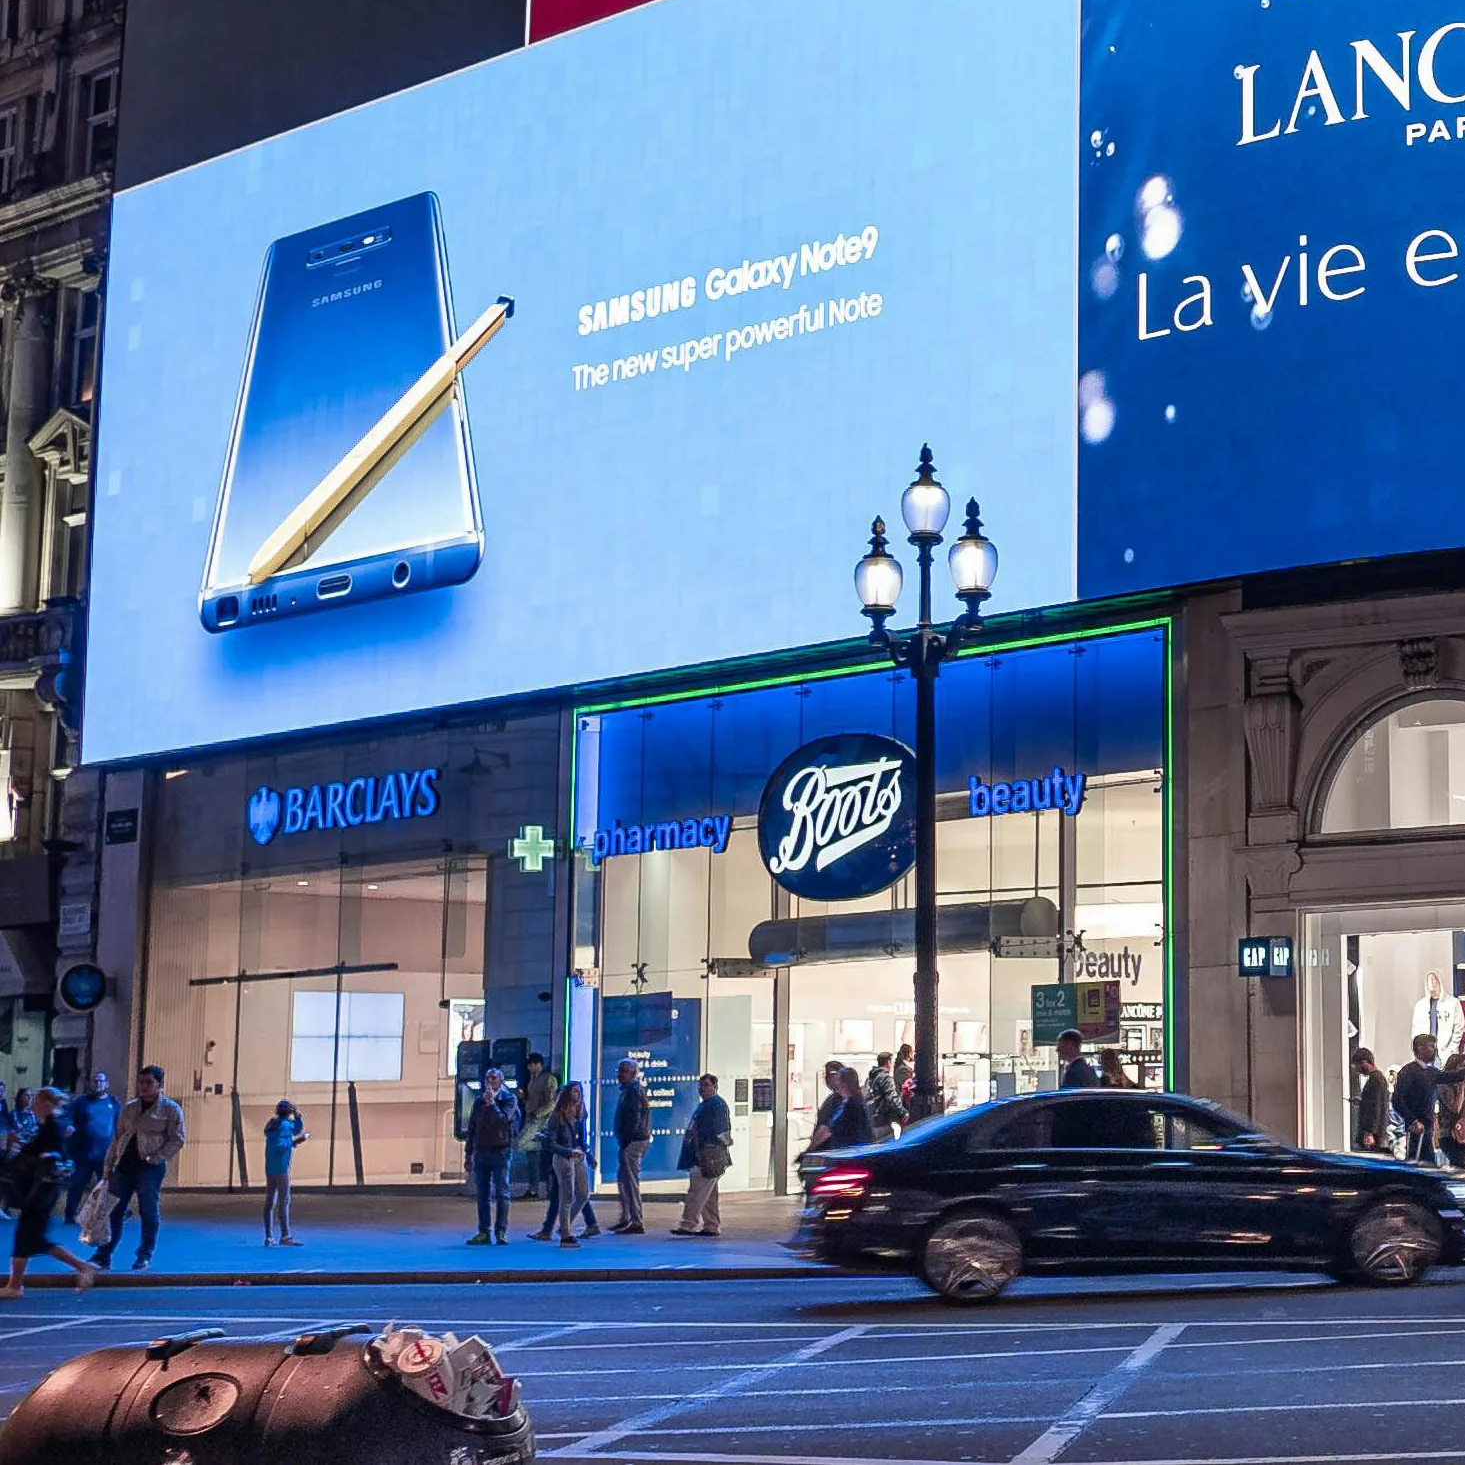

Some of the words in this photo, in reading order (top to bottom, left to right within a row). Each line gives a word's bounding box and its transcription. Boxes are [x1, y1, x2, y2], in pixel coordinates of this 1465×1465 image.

[311, 279, 382, 308] SAMSUNG
[577, 276, 697, 336] SAMSUNG
[704, 252, 798, 301] Galaxy
[800, 225, 879, 276] Note9
[1138, 272, 1213, 341] La
[1241, 233, 1366, 318] vie
[571, 364, 609, 392] The
[612, 350, 658, 382] new
[661, 334, 722, 372] super
[725, 303, 826, 361] powerful
[829, 291, 884, 327] Note
[284, 768, 439, 834] BARCLAYS
[769, 755, 903, 874] Boots
[967, 764, 1086, 818] beauty
[592, 813, 732, 866] pharmacy
[1243, 947, 1266, 967] GAP
[1035, 991, 1045, 1008] 3
[1057, 990, 1065, 1007] 2
